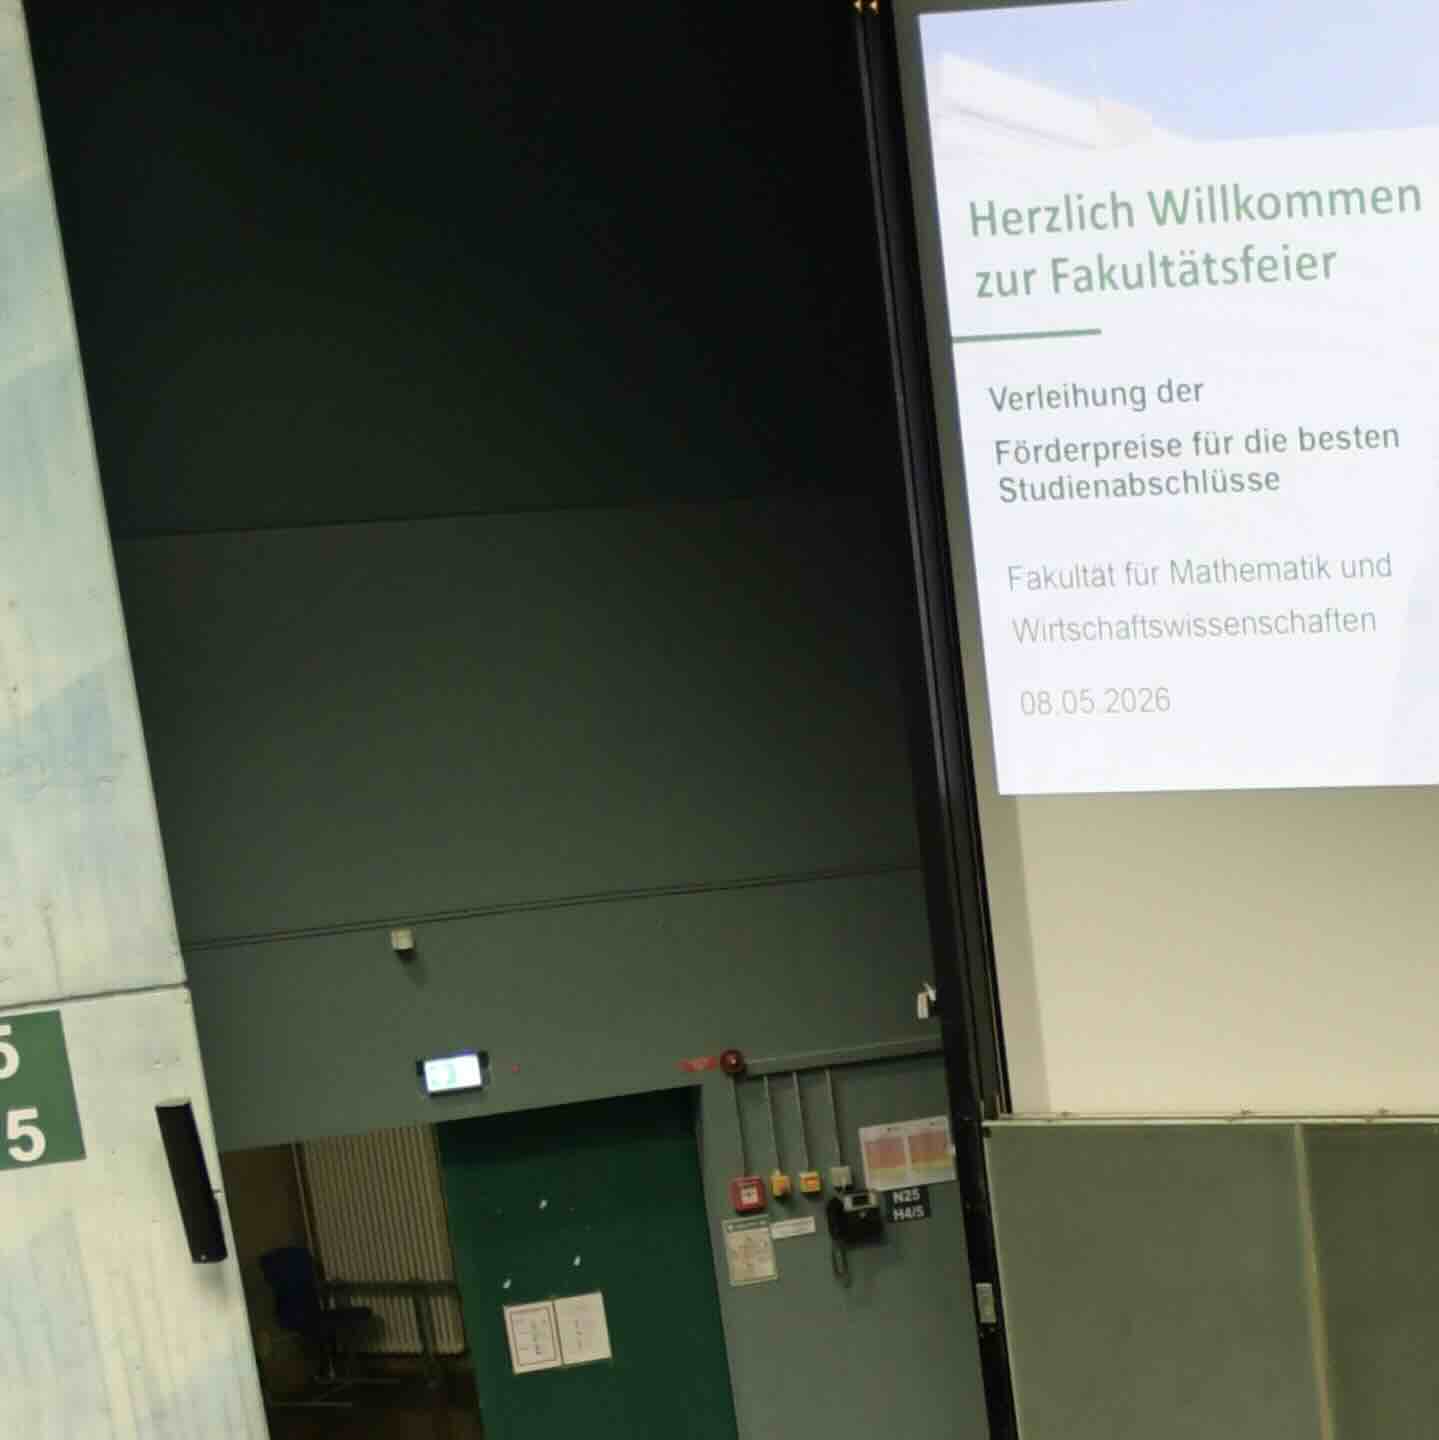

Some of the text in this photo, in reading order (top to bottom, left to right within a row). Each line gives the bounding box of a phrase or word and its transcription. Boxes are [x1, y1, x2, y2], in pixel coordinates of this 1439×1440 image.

[970, 184, 1421, 237] Herzlich Willkommen
[976, 244, 1336, 298] zur Fakultätsfeier
[988, 378, 1204, 412] Verleihung der
[995, 425, 1399, 468] Förderpreise für die besten
[1000, 469, 1280, 503] Studienabschlüsse
[1008, 553, 1392, 592] Fakultät für Mathematik und
[1012, 609, 1376, 644] Wirtschaftswissenschaften
[1021, 687, 1170, 716] 08.05.2026
